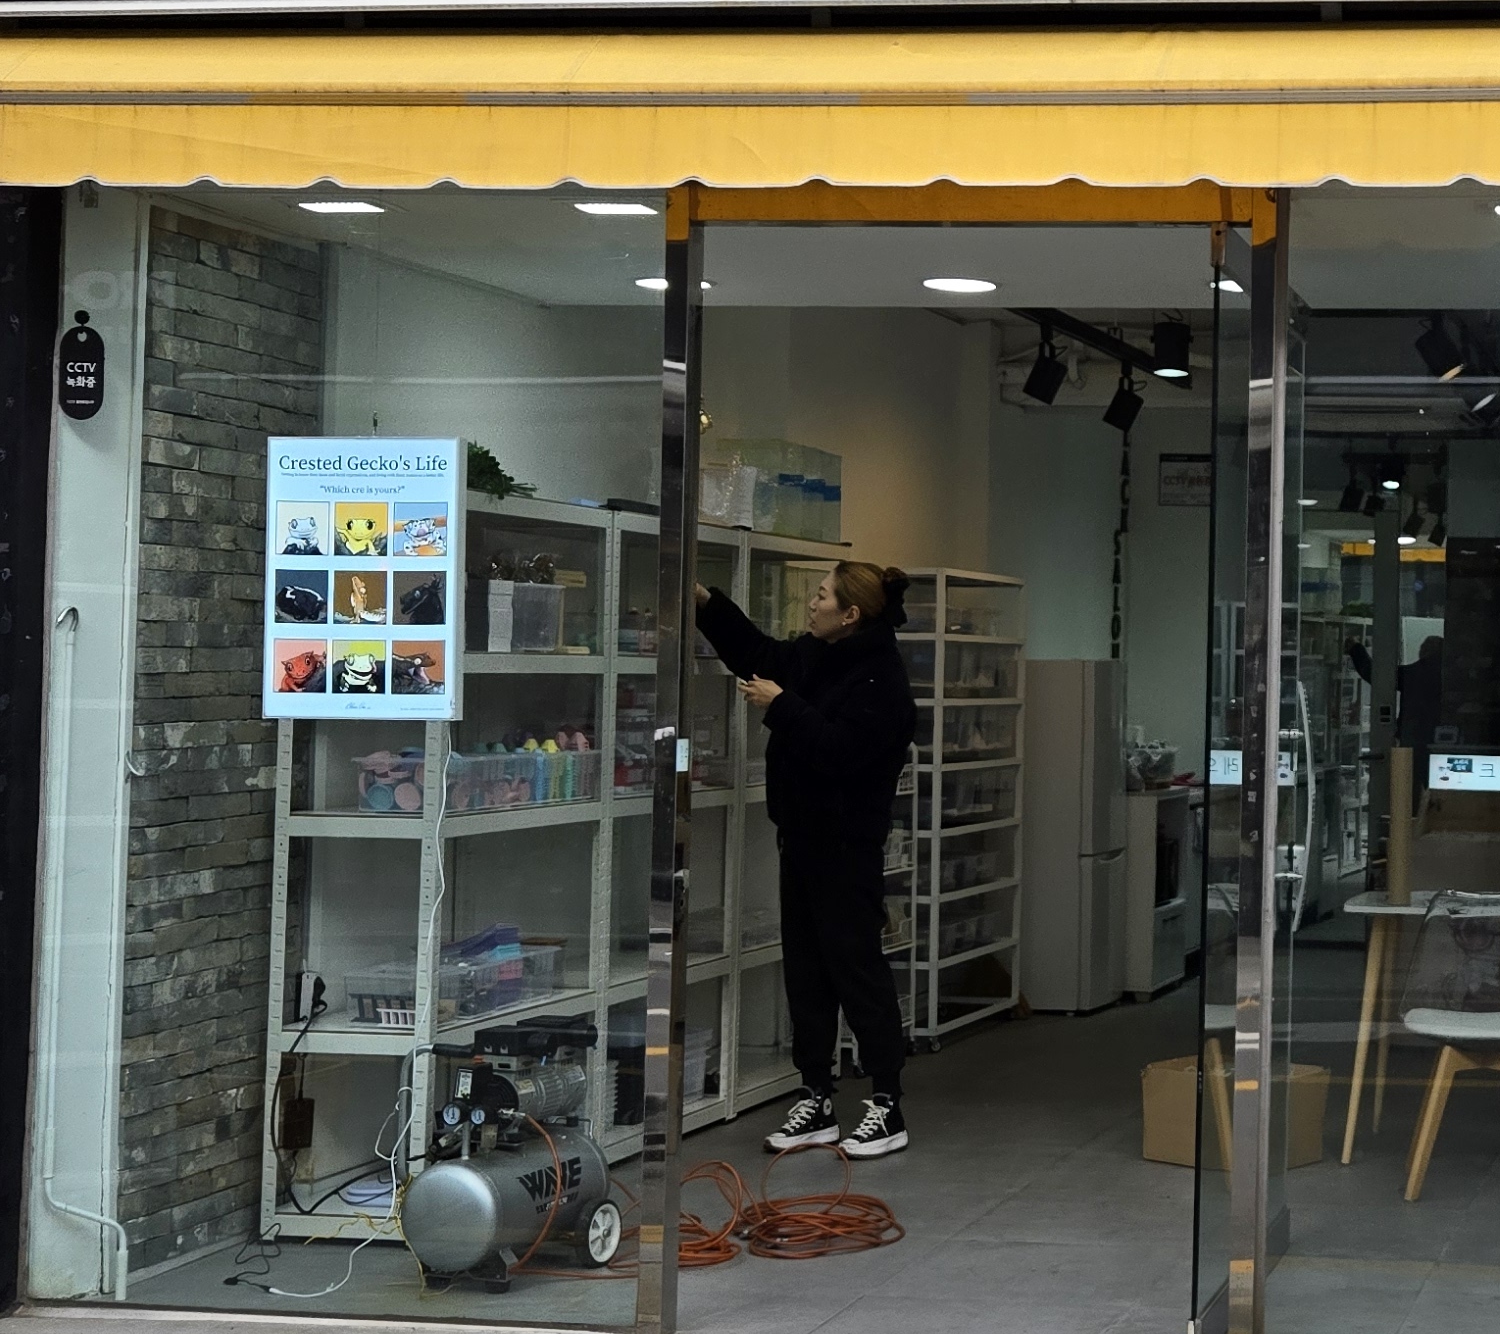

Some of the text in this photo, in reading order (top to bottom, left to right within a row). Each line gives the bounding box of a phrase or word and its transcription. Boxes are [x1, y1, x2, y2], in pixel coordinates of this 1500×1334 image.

[66, 362, 96, 372] CCTV
[66, 376, 96, 388] 녹화중
[278, 454, 448, 471] Crested Gecko's Life
[351, 486, 365, 495] cre
[366, 484, 373, 495] is
